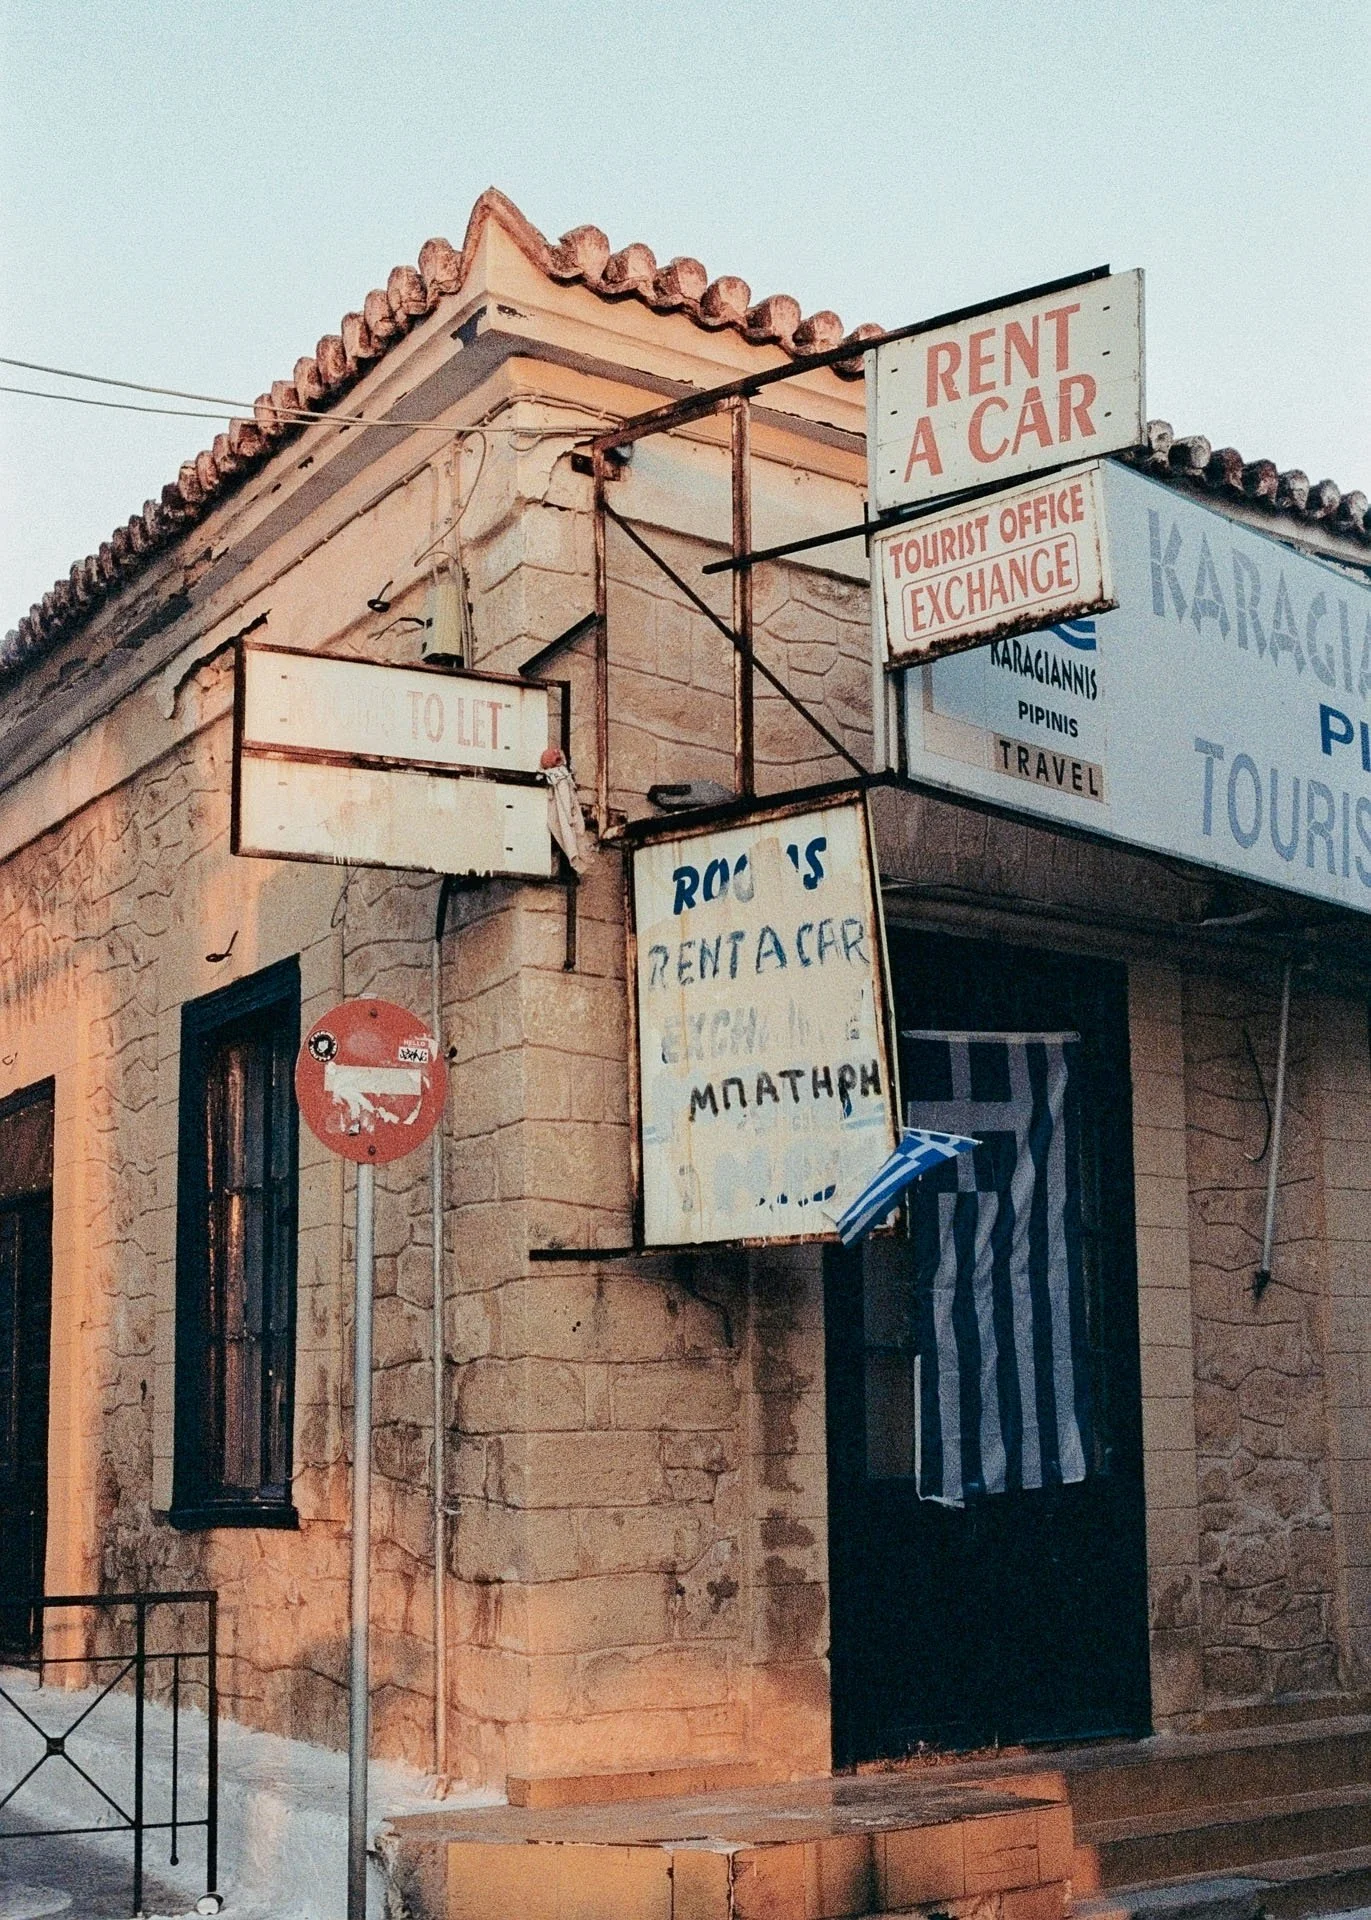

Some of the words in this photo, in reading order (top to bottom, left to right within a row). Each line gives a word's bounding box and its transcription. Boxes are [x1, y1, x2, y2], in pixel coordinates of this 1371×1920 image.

[926, 302, 1081, 408] RENT
[904, 415, 944, 484] A
[967, 373, 1098, 464] CAR
[889, 514, 990, 579] TOURIST
[1000, 483, 1085, 544] OFFICE
[910, 541, 1073, 632] EXCHANGE
[990, 639, 1098, 701] KARAGIANNIS
[407, 690, 445, 743] TO
[457, 697, 503, 750] LET
[1018, 700, 1079, 738] PIPINIS
[1000, 739, 1099, 796] TRAVEL
[648, 930, 746, 990] RENT
[755, 925, 788, 975] A
[796, 918, 870, 968] CAR
